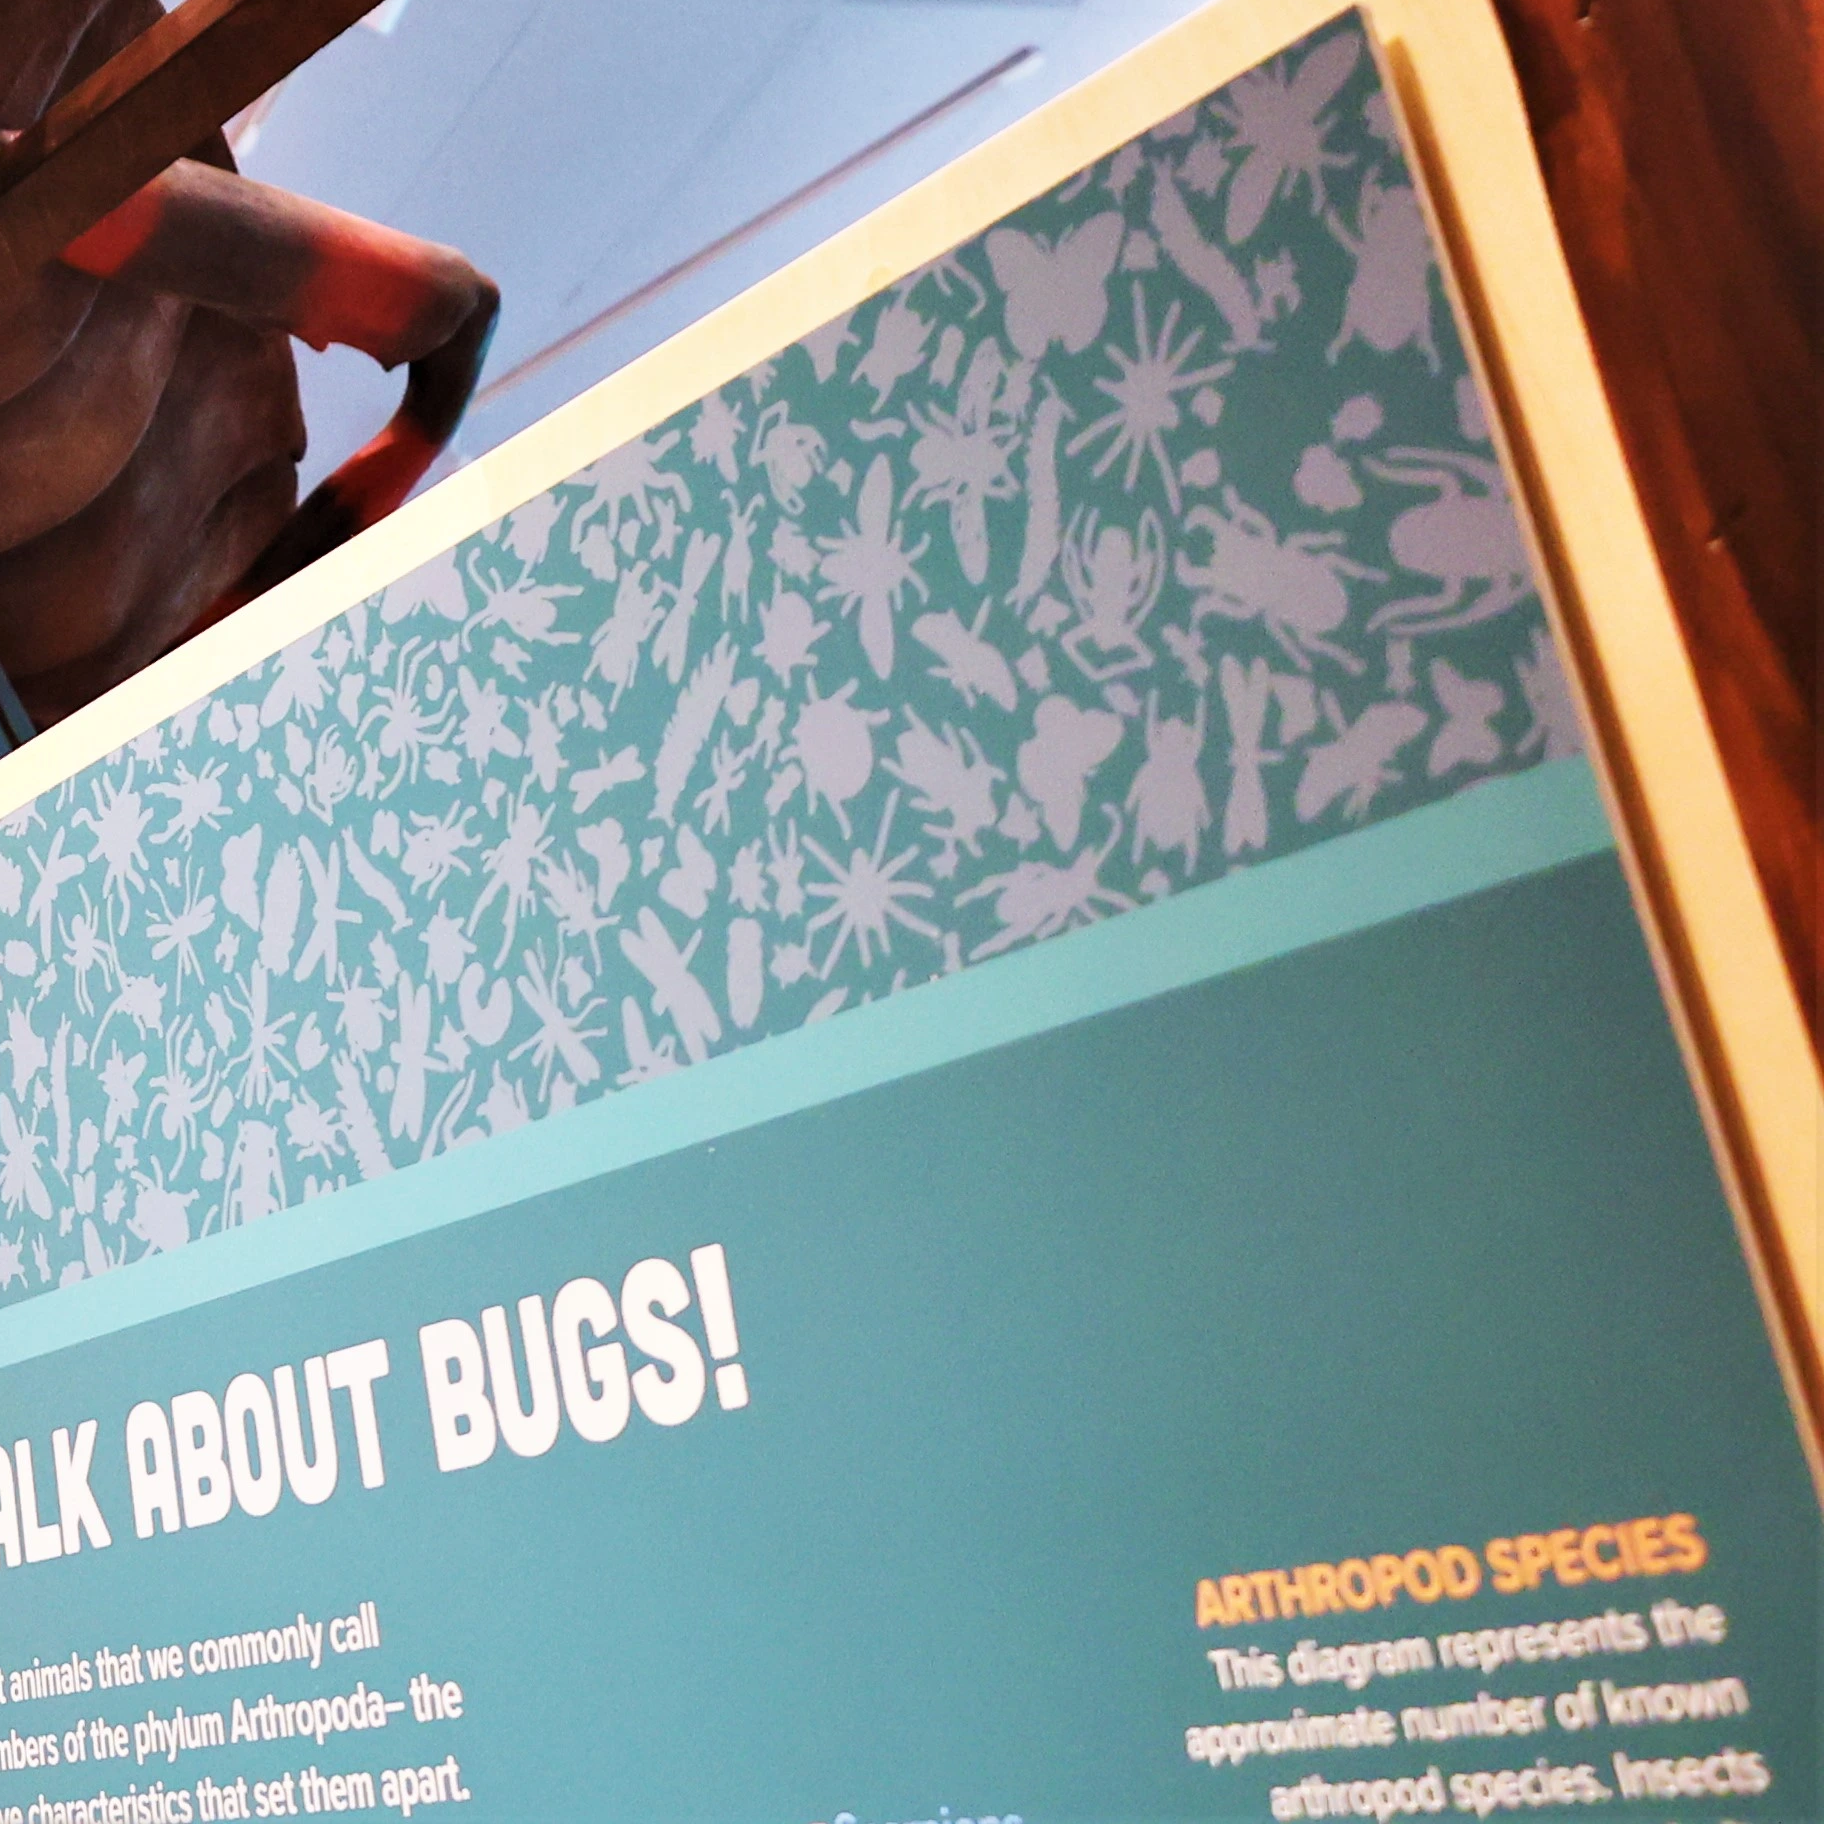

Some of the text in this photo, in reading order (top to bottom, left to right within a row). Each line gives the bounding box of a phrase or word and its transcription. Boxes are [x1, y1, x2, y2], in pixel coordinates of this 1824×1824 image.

[125, 1338, 390, 1539] ABOUT
[418, 1243, 749, 1473] BUGS!
[1195, 1512, 1709, 1629] ARTHROPOD SPECIES
[10, 1651, 92, 1703] animals
[95, 1644, 144, 1689] that
[147, 1645, 184, 1680] we
[189, 1613, 322, 1675] commonly
[330, 1601, 380, 1653] call
[1206, 1597, 1727, 1691] This diagram represents the
[63, 1719, 87, 1763] of
[90, 1717, 130, 1761] the
[134, 1706, 225, 1766] phylum
[409, 1672, 463, 1723] the
[1184, 1677, 1750, 1766] approximate number of known
[28, 1781, 193, 1824] characteristics
[196, 1776, 251, 1823] that
[254, 1771, 298, 1816] set
[300, 1765, 376, 1814] them
[381, 1754, 471, 1817] apart.
[1270, 1749, 1771, 1824] arthropod species. Insects
